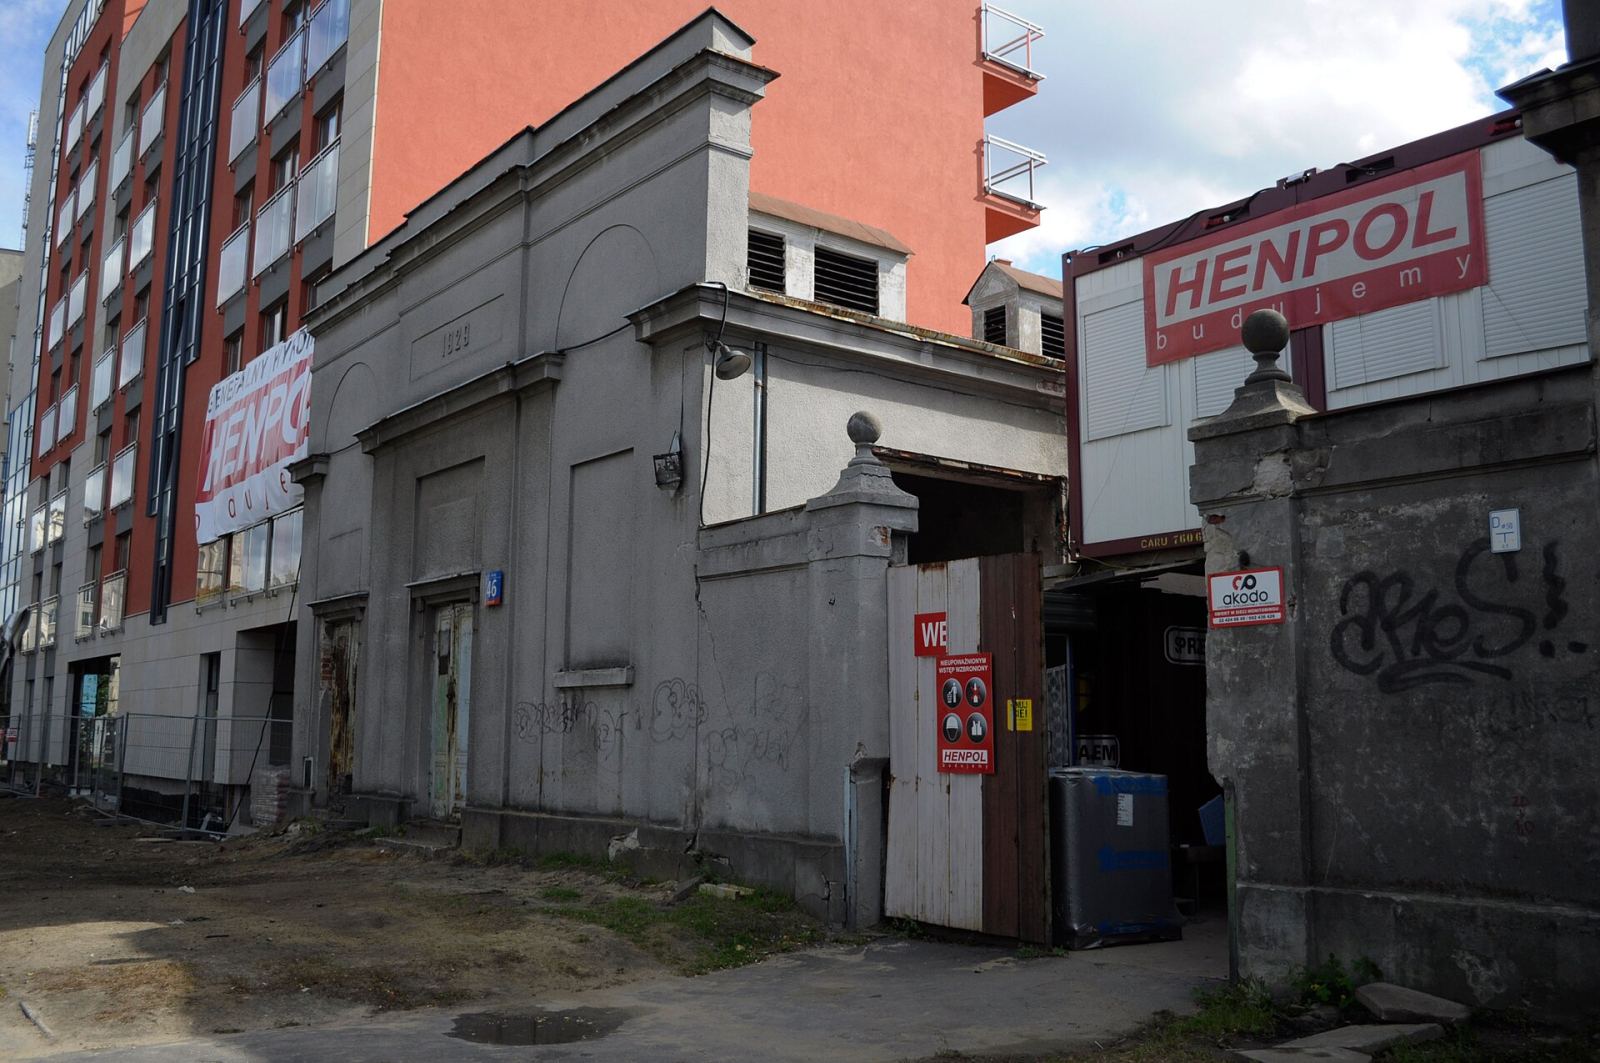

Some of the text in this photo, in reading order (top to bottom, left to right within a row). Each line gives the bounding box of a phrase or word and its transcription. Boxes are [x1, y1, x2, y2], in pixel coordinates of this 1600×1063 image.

[1164, 190, 1458, 317] HENPOL
[208, 356, 269, 413] ENERALNY
[486, 579, 496, 597] 46
[1223, 590, 1268, 605] akodo
[944, 751, 986, 762] HENPOL
